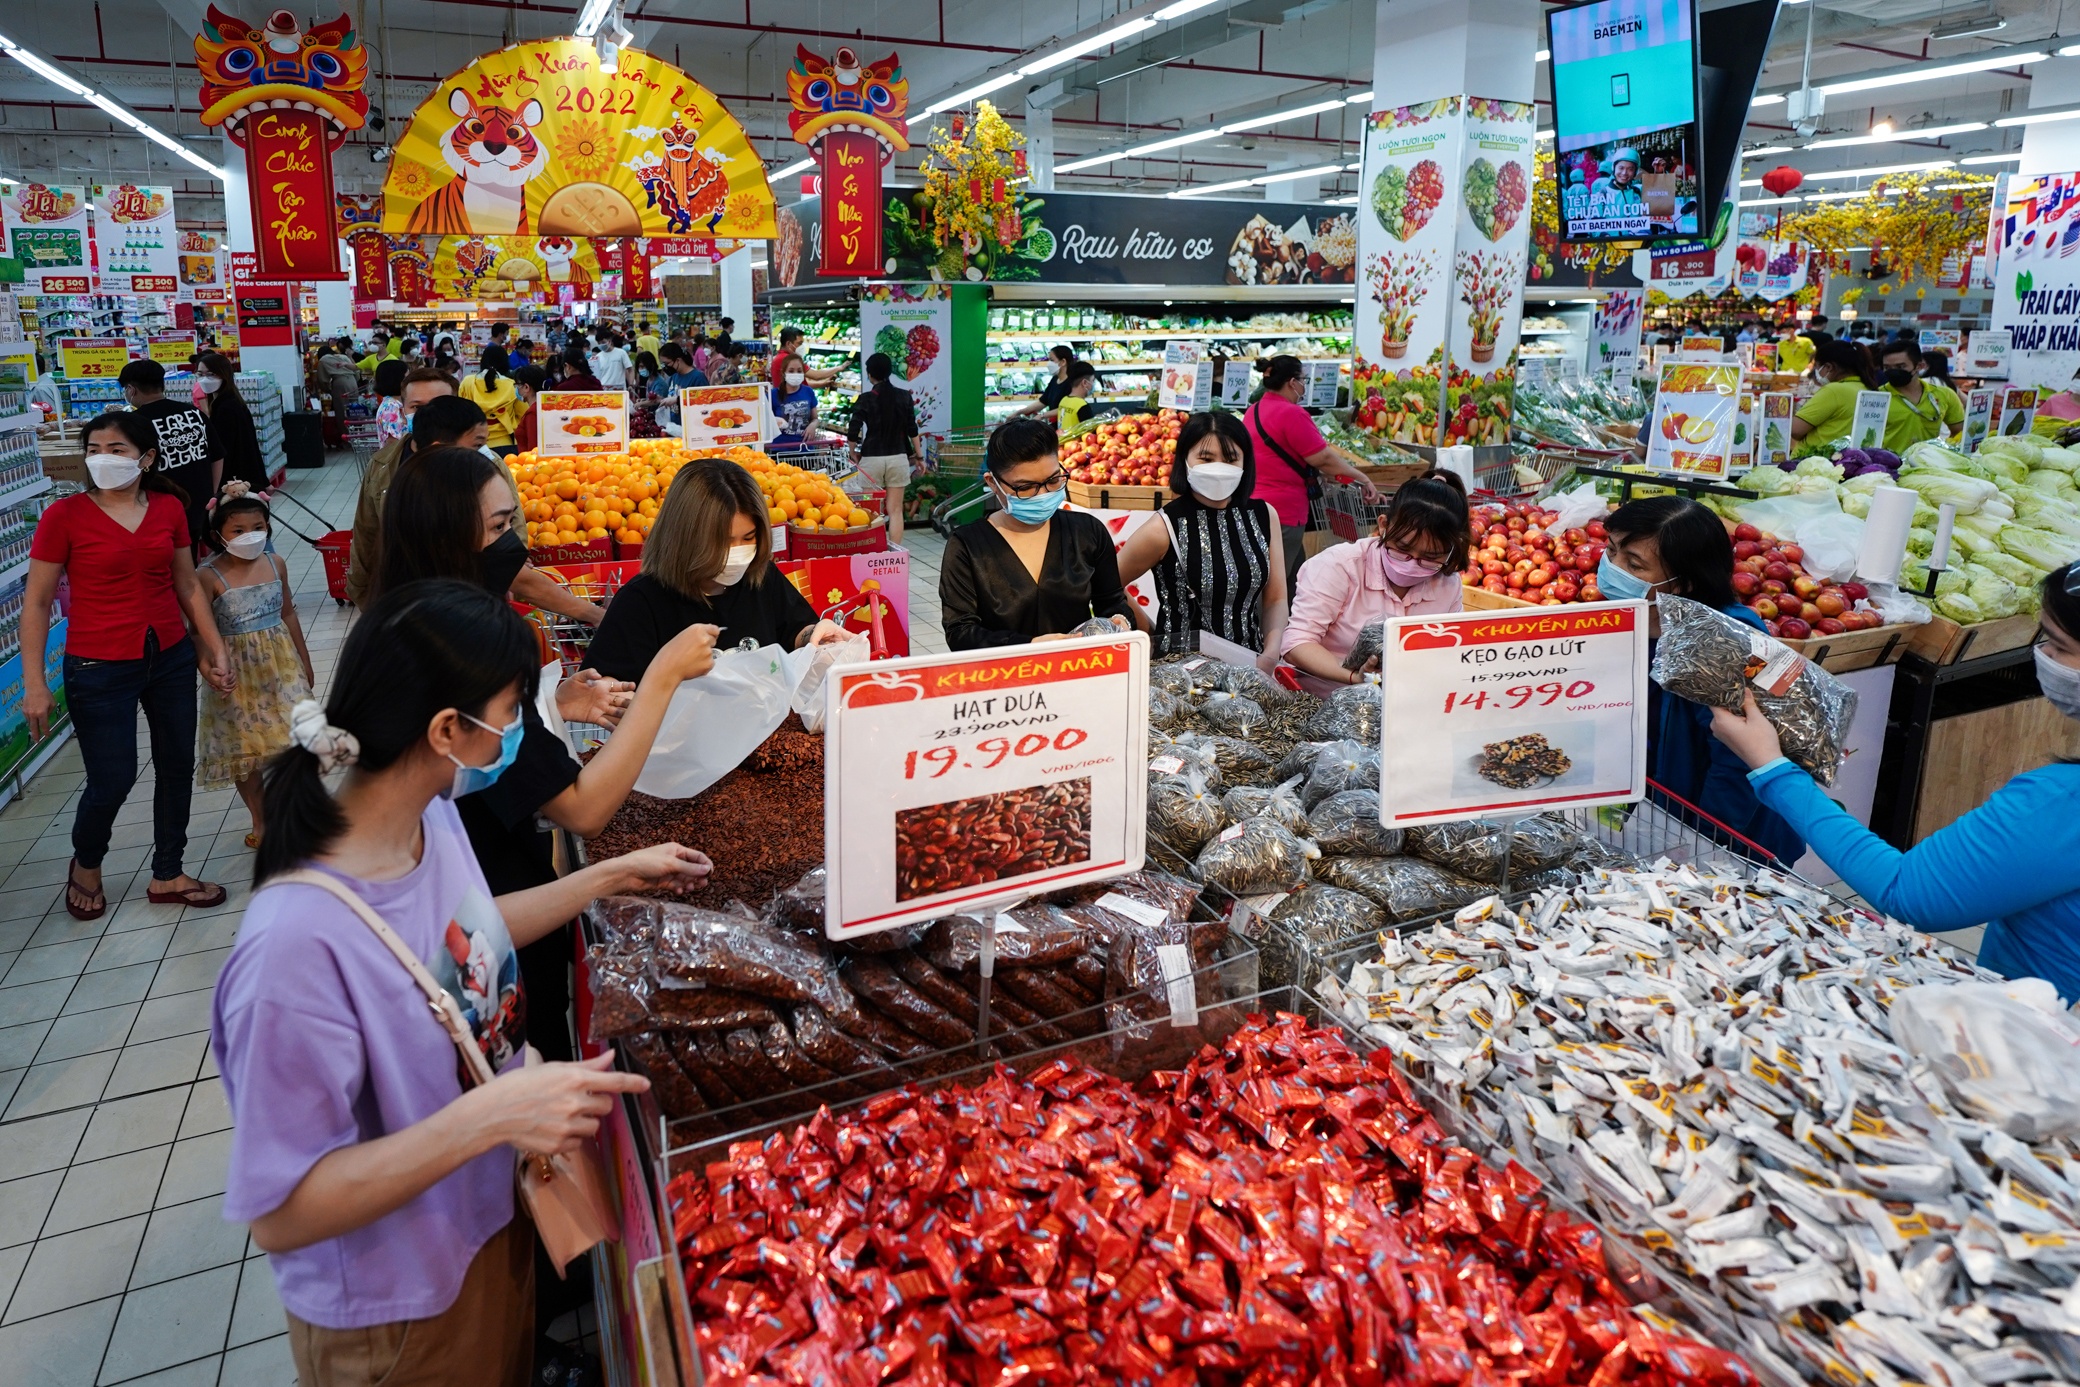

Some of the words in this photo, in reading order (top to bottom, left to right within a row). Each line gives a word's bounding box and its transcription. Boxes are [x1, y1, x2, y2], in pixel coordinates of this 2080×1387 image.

[1594, 20, 1642, 40] BAEMIN
[535, 52, 592, 75] Xuân
[556, 86, 637, 116] 2022
[257, 115, 316, 151] Cung
[1422, 133, 1446, 142] NGON
[1509, 135, 1528, 144] NGON
[266, 150, 316, 173] Chúc
[837, 142, 864, 169] Vạn
[843, 174, 860, 197] Sự
[272, 182, 305, 214] Tân
[838, 200, 864, 226] Như
[1589, 220, 1622, 231] BAEMIN
[1624, 219, 1648, 229] NGAY
[271, 212, 317, 268] Xuân
[841, 226, 863, 265] Ý
[1063, 224, 1119, 264] Rau
[1122, 228, 1177, 259] hữu
[1183, 237, 1214, 260] cơ
[1682, 244, 1705, 254] SÁNH
[1660, 261, 1680, 278] 16
[44, 279, 65, 291] 26
[134, 278, 154, 290] 25
[2018, 283, 2053, 316] TRÁI
[2004, 318, 2047, 358] NHẬP
[2047, 315, 2080, 352] KHẨ
[82, 364, 102, 374] 23
[808, 542, 826, 550] CITRUS
[826, 541, 856, 550] AUSTRALIAN
[857, 537, 876, 547] PREMIUM
[557, 548, 607, 562] Dragon
[868, 558, 906, 568] CENTRAL
[873, 567, 900, 576] RETAIL
[1472, 617, 1568, 638] KHUYẾN
[1574, 612, 1621, 630] MÃI
[1460, 648, 1498, 667] KẸO
[1505, 645, 1544, 664] GẠO
[1549, 638, 1587, 656] LỨT
[937, 660, 1053, 688] KHUYẾN
[1060, 652, 1114, 673] MÃI
[1471, 666, 1568, 684] 15.990VND
[954, 698, 997, 722] HẠT
[1005, 690, 1048, 712] DƯA
[1443, 680, 1596, 714] 14.990
[1566, 700, 1633, 713] VND/100G
[934, 712, 1060, 741] 23.900VND
[904, 728, 1088, 780] 19.900
[1042, 756, 1115, 776] VND/100G
